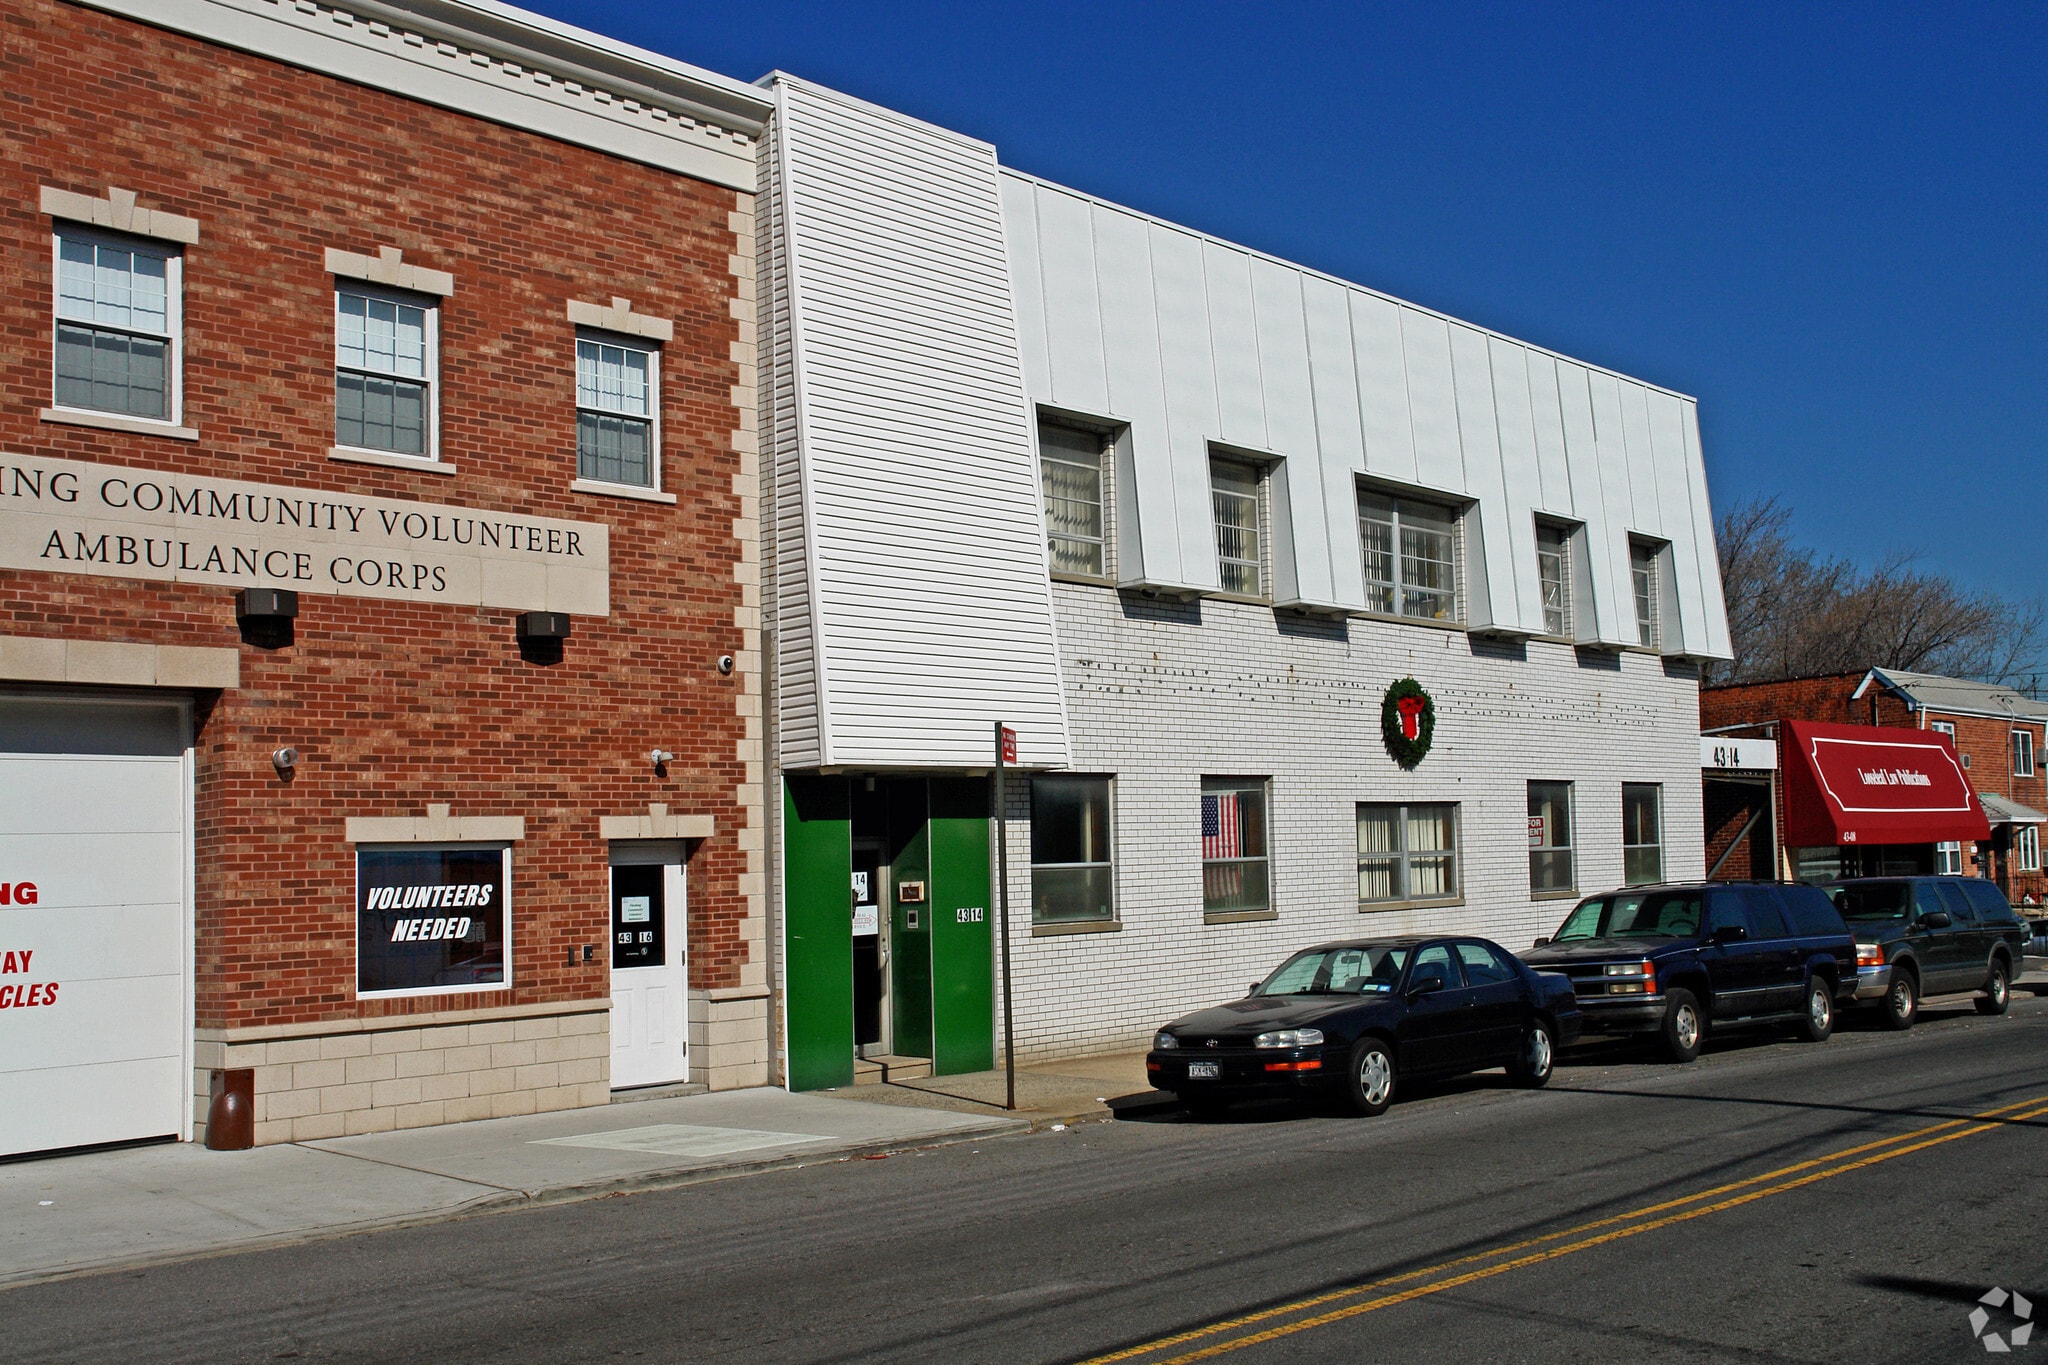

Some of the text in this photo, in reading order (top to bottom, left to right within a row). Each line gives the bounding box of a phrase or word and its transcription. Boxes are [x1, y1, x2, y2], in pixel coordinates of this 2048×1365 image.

[100, 478, 365, 533] COMMUNITY
[378, 509, 585, 557] VOLUNTEER
[40, 529, 446, 592] AMBULANCE CORPS
[1528, 828, 1543, 836] ENT
[366, 884, 493, 910] VOLUNTEERS
[391, 917, 471, 942] NEEDED
[619, 932, 652, 943] 43 16
